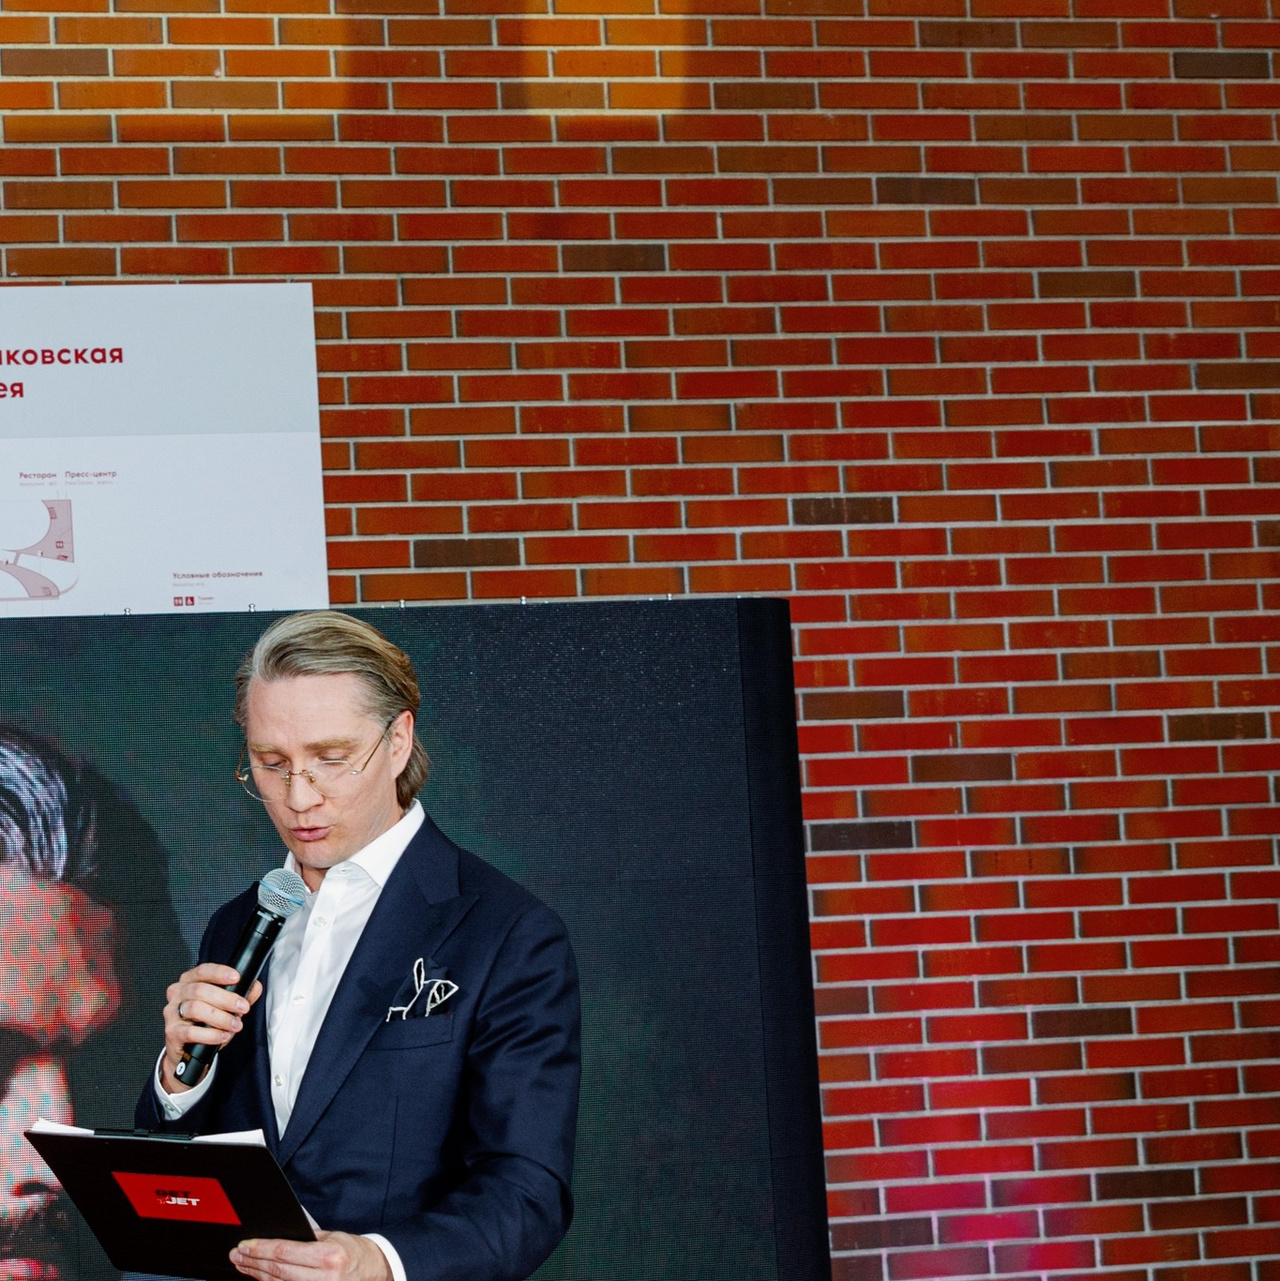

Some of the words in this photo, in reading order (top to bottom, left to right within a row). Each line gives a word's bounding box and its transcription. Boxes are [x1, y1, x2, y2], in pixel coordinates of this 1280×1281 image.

[19, 471, 57, 480] Ресторан
[64, 471, 117, 479] Пресс-центр
[172, 572, 210, 580] Условные
[211, 571, 263, 579] обозначения
[165, 1197, 200, 1206] JET
